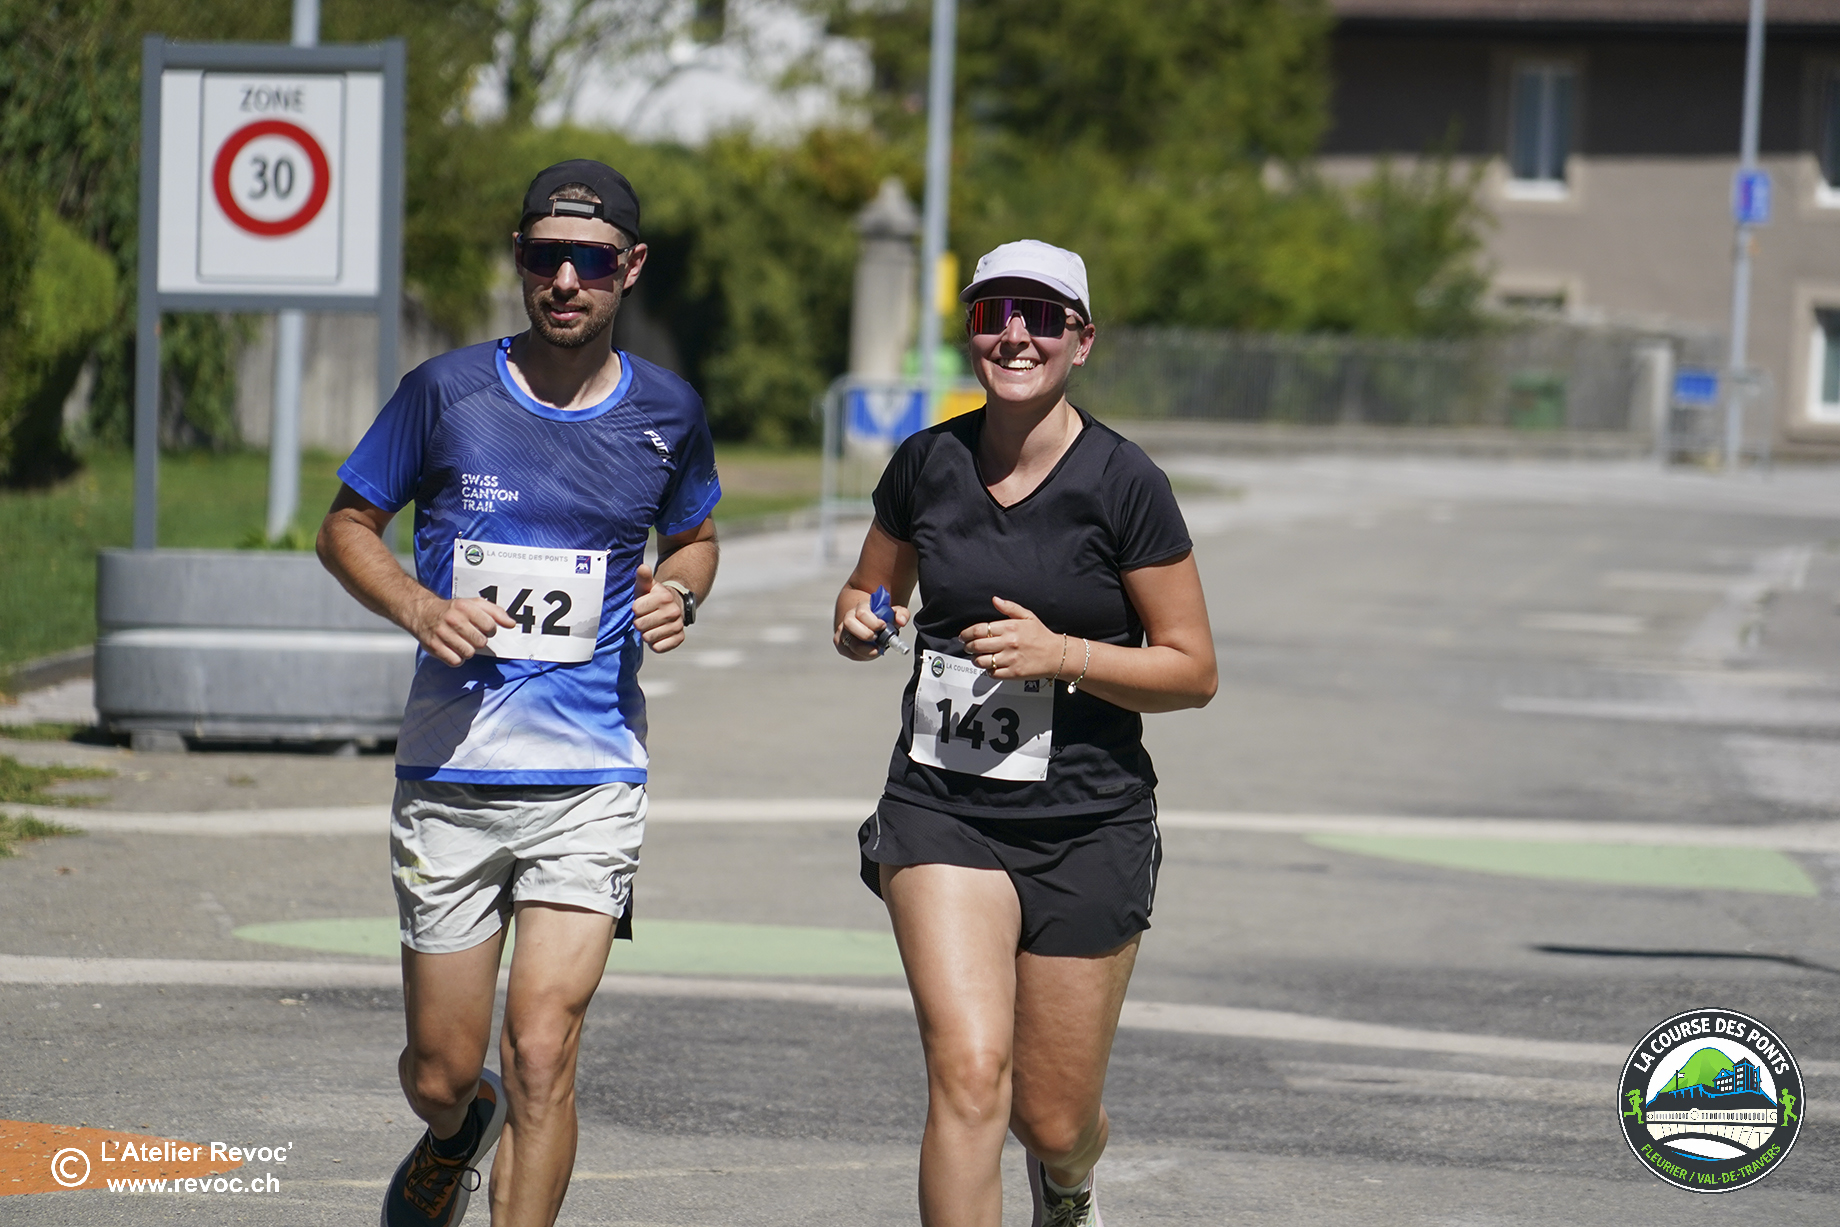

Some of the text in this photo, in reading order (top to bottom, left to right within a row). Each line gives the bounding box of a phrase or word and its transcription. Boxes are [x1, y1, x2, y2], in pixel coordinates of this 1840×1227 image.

[239, 85, 306, 112] ZONE
[248, 157, 295, 200] 30
[461, 486, 519, 502] CANYON
[461, 498, 496, 513] TRAIL
[498, 551, 527, 560] COURSE
[545, 555, 569, 563] PONTS
[953, 664, 978, 675] COURSE
[936, 697, 1021, 754] 143
